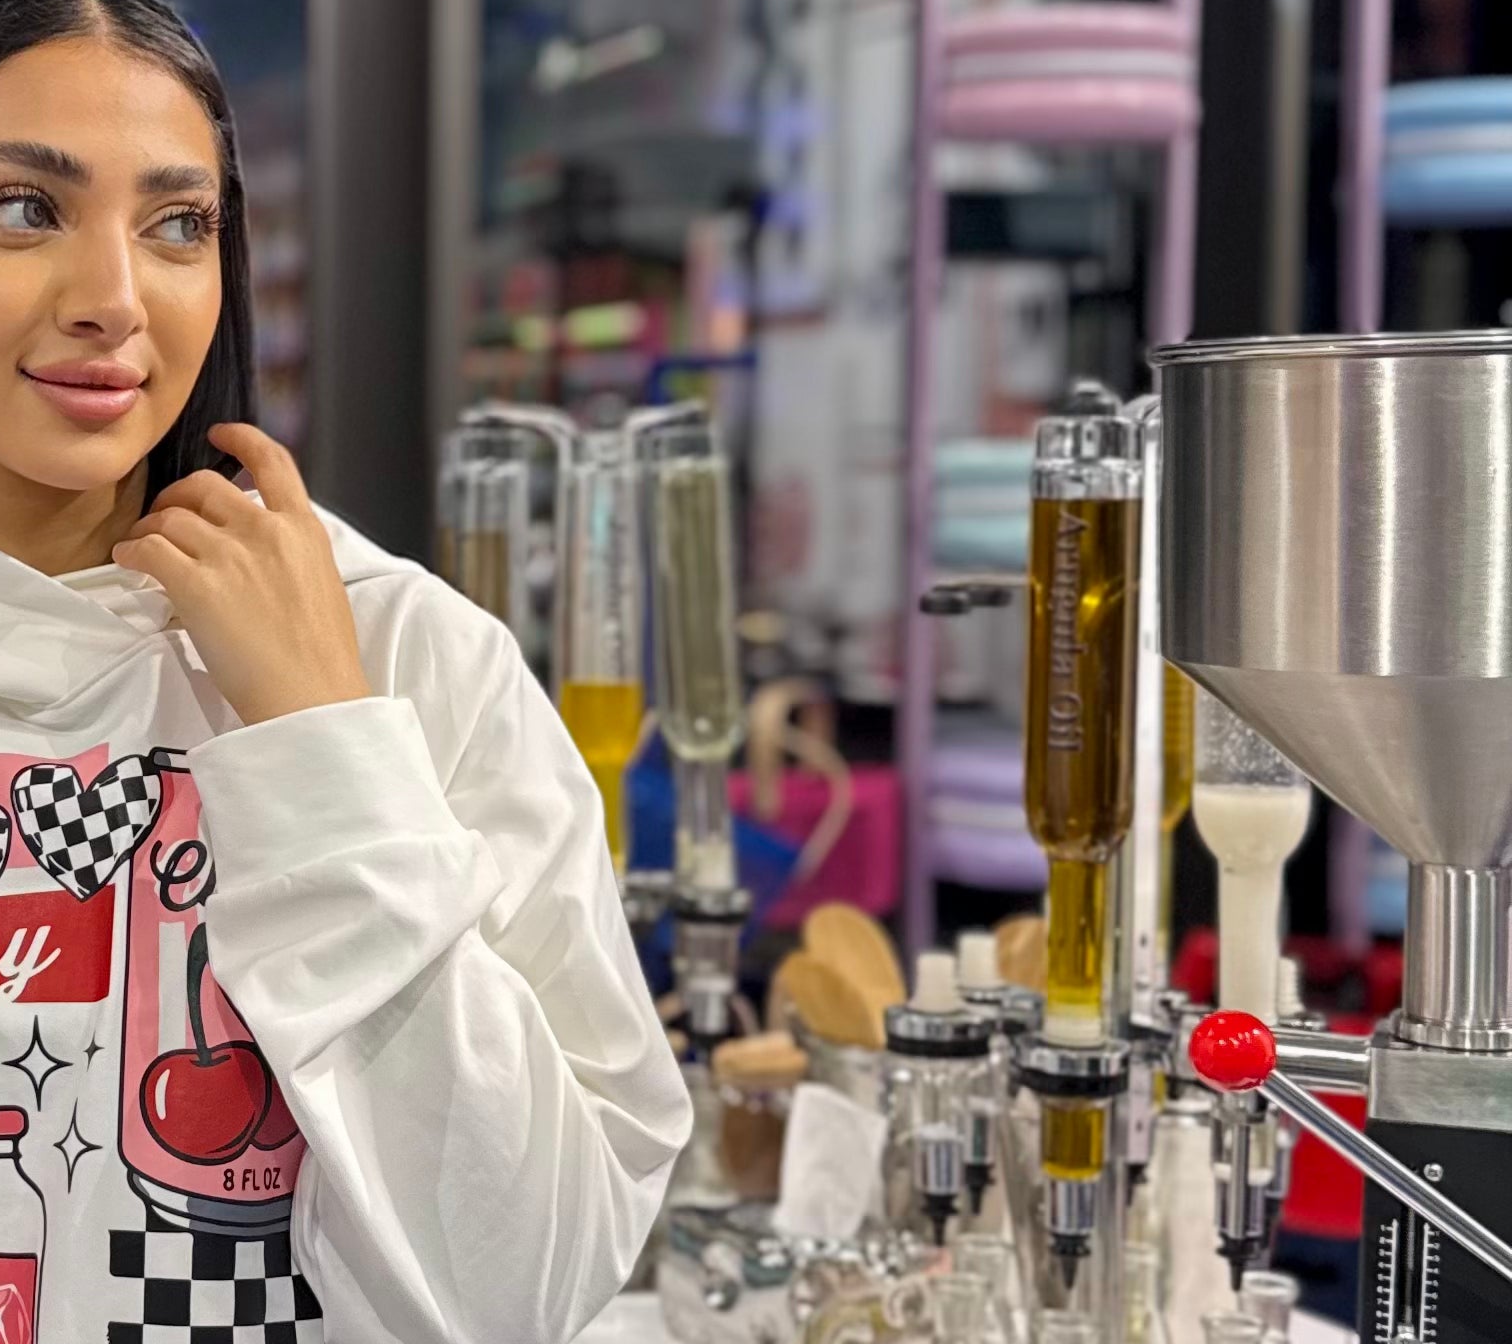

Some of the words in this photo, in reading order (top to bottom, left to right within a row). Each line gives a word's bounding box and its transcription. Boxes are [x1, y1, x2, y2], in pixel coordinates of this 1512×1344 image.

[1048, 692, 1084, 751] Oil
[222, 1167, 235, 1192] 8
[241, 1167, 261, 1192] FL
[263, 1166, 281, 1190] OZ
